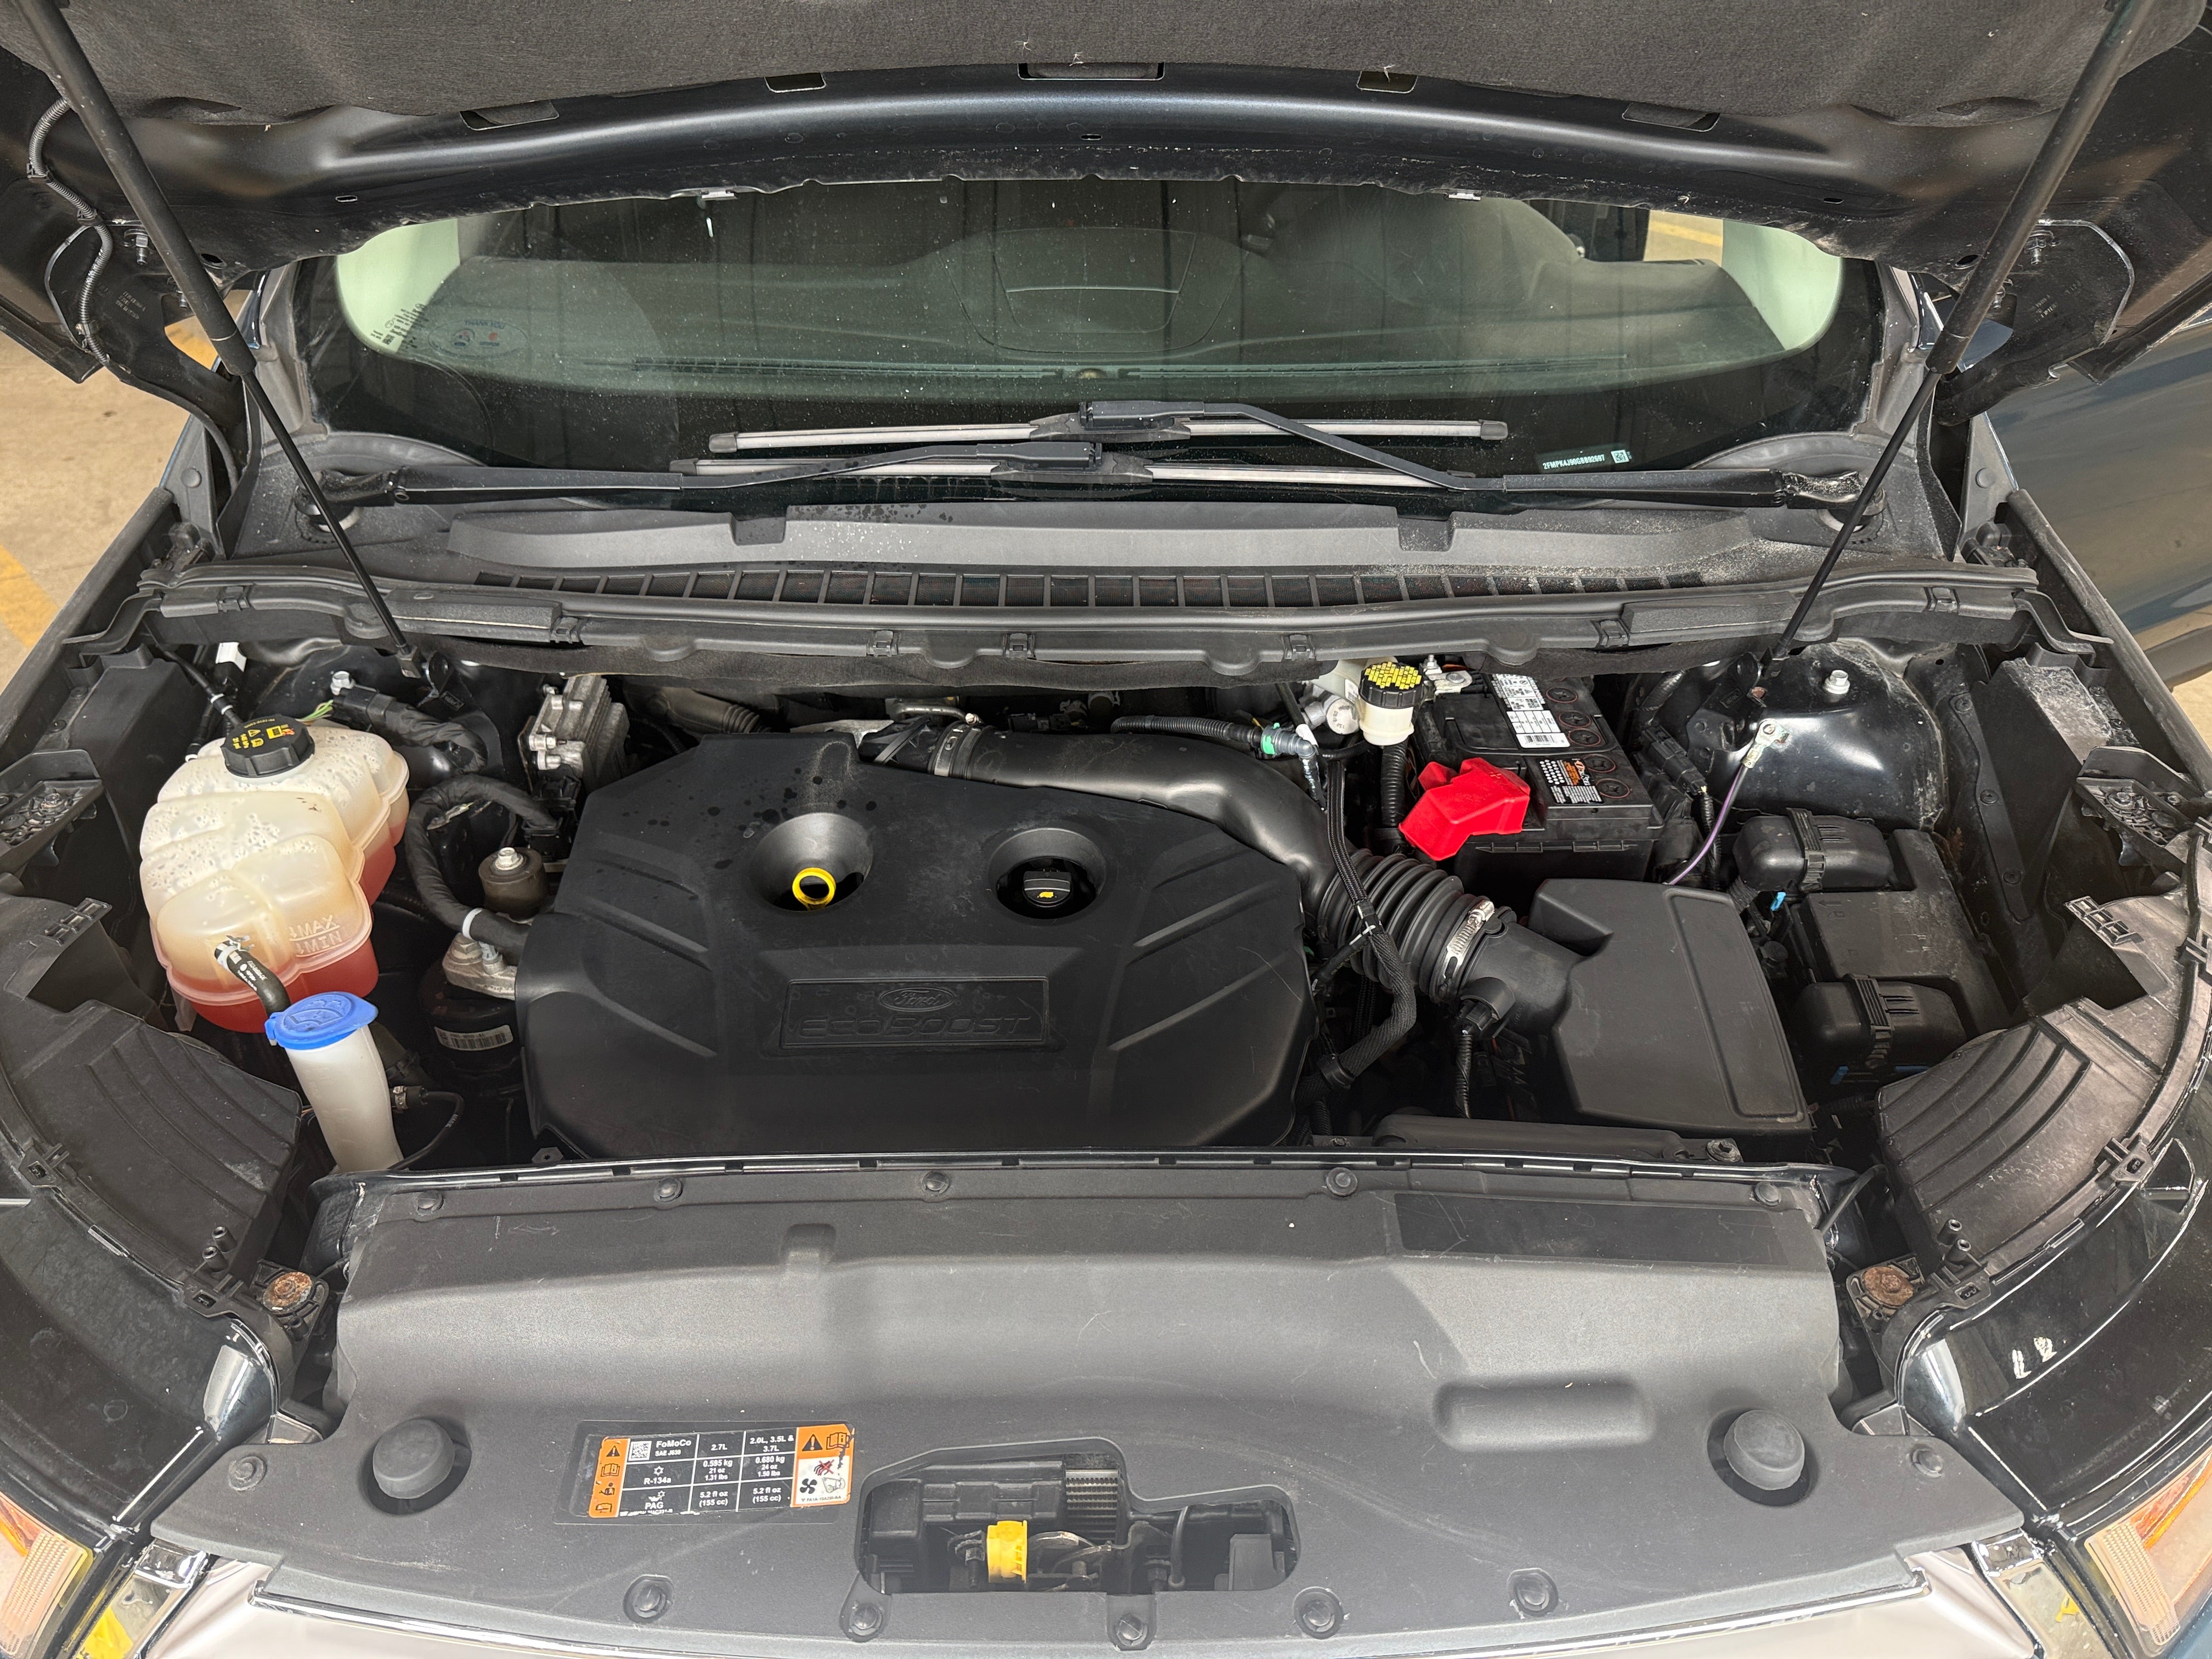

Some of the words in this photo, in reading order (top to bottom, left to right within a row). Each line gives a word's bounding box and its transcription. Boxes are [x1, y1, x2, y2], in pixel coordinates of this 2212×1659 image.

[297, 915, 336, 937] MAX
[304, 931, 342, 953] MIN
[893, 989, 943, 1007] Ford
[656, 1439, 692, 1448] FoMoCo
[703, 1459, 723, 1468] 0.595
[723, 1459, 733, 1468] kg
[776, 1455, 785, 1464] kg
[699, 1499, 715, 1508] (155
[716, 1498, 729, 1506] cc)
[752, 1496, 768, 1504] (155
[645, 1501, 664, 1510] PAG
